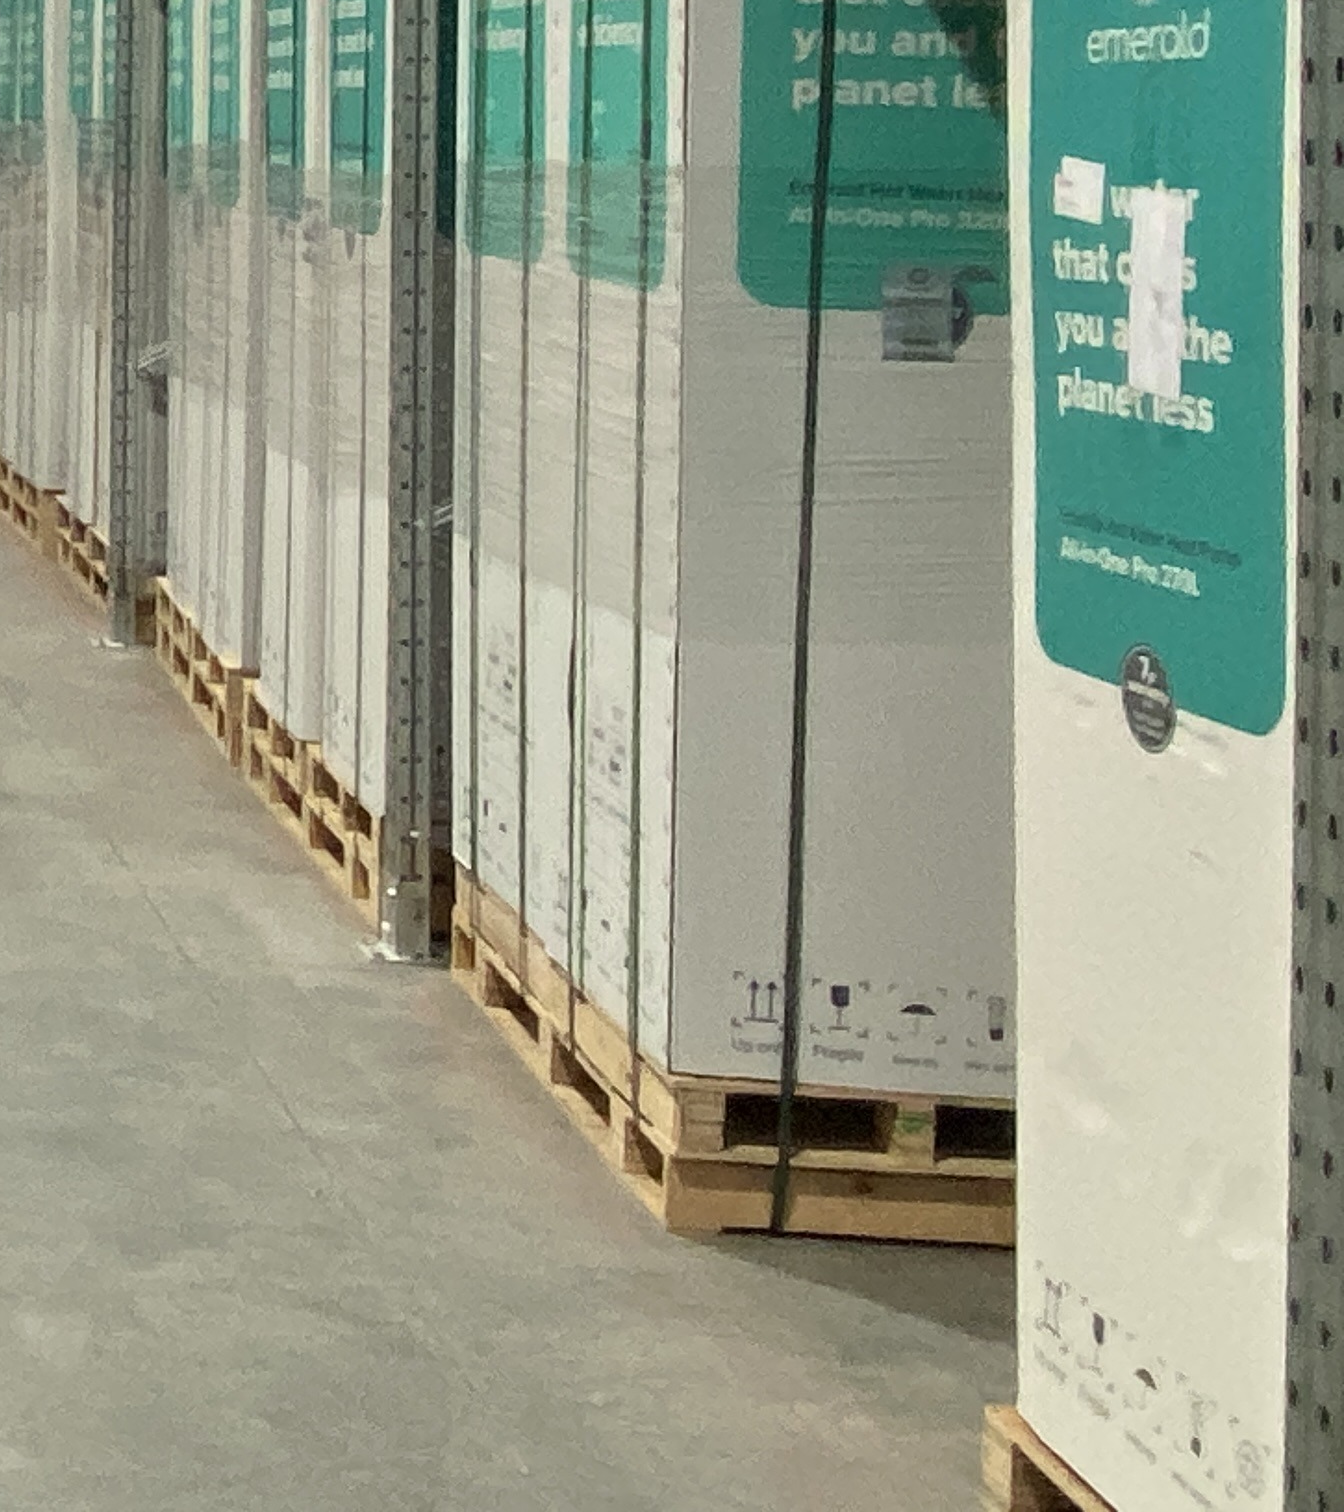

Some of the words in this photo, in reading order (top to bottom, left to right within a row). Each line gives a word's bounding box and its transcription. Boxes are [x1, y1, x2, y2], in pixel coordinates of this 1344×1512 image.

[1087, 6, 1210, 64] emerald
[1053, 237, 1110, 284] that
[1055, 310, 1104, 354] you
